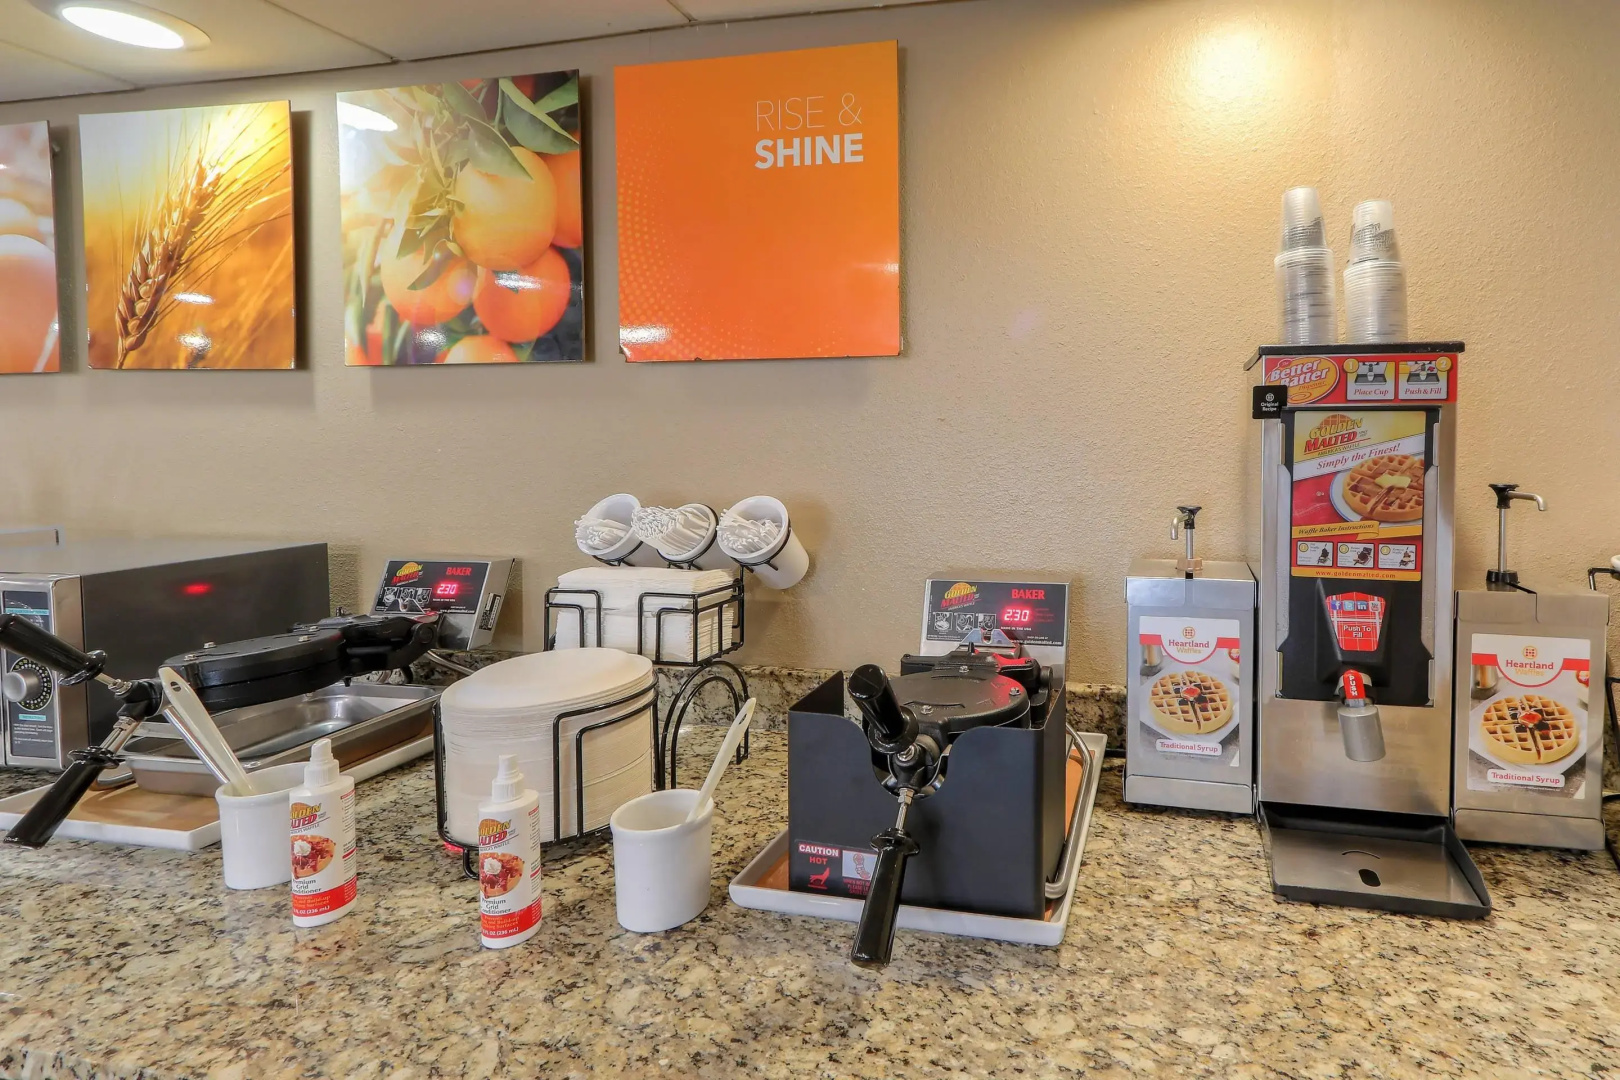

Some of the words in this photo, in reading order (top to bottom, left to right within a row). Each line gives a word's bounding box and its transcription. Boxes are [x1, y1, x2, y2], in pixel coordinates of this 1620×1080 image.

[756, 96, 825, 131] RISE
[838, 92, 862, 126] &
[754, 132, 864, 169] SHINE
[1270, 360, 1321, 382] Better
[1281, 368, 1329, 387] Batter
[1354, 388, 1373, 396] Place
[1374, 388, 1389, 397] Cup
[1405, 387, 1422, 395] Push
[1429, 387, 1442, 395] Fill
[1309, 417, 1363, 439] GOLDEN
[1304, 431, 1358, 453] MALTED
[1316, 455, 1349, 470] Simply
[1351, 452, 1367, 462] the
[1368, 442, 1401, 458] Finest!
[1298, 526, 1318, 535] Waffle
[1337, 523, 1375, 532] Instructions
[446, 567, 472, 576] BAKER
[1316, 570, 1396, 579] www.goldenmalted.com
[1011, 588, 1045, 600] BAKER
[1168, 639, 1210, 649] Heartland
[1505, 659, 1554, 670] Heartland
[1515, 669, 1545, 677] Waffles
[1349, 675, 1358, 696] PUSH
[1159, 741, 1196, 750] Traditional
[1197, 744, 1219, 753] Syrup
[1491, 772, 1534, 782] Traditional
[1535, 775, 1561, 785] Syrup
[799, 844, 839, 857] CAUTION
[809, 856, 828, 865] HOT
